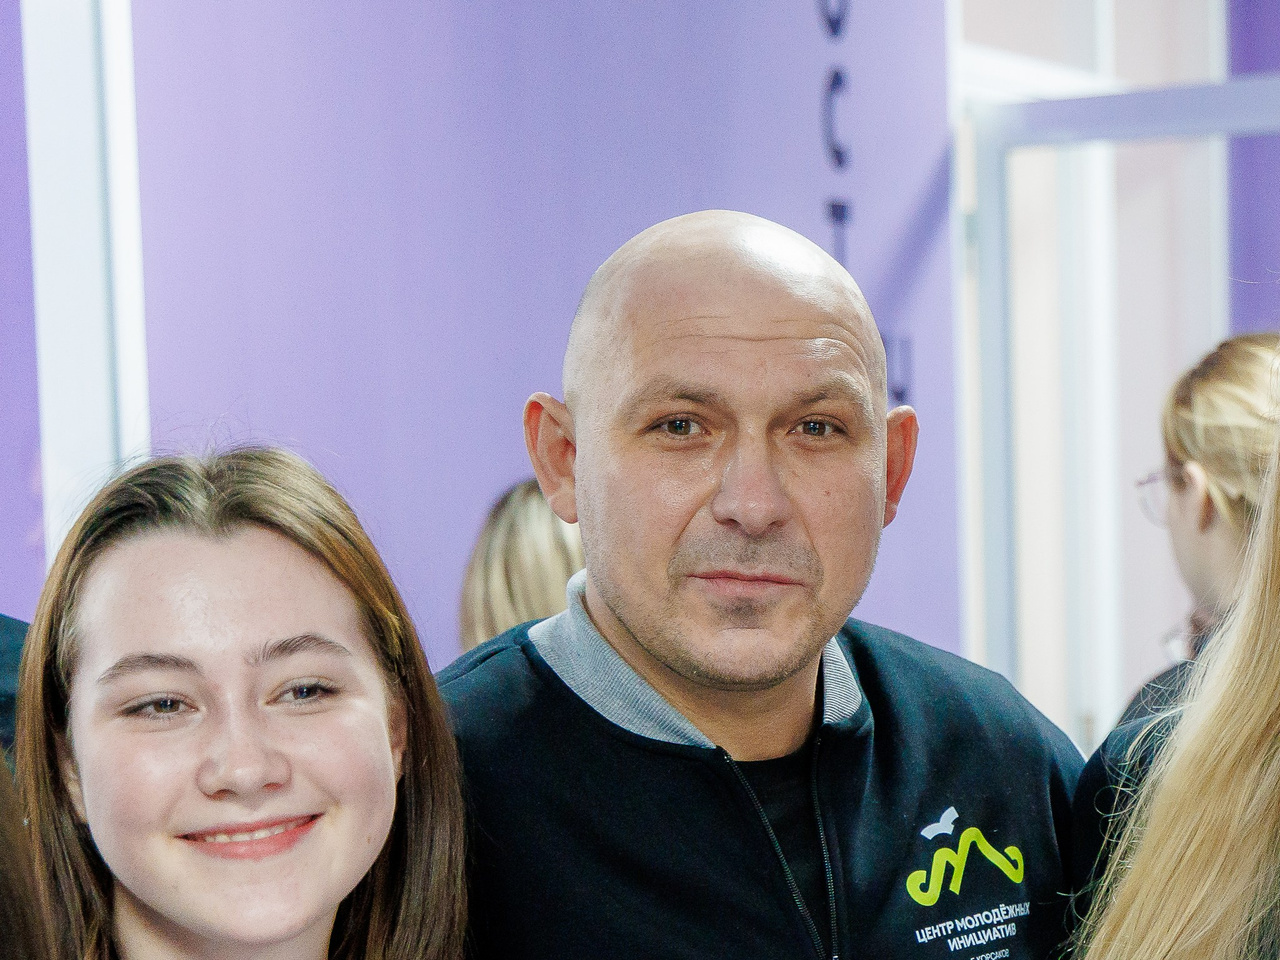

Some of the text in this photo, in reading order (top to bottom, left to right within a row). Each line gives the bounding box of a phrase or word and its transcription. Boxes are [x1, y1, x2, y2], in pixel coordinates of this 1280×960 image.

[915, 902, 1031, 943] ЦЕНТР МОЛОДЁЖНЫХ
[947, 922, 1017, 951] ИНИЦИАТИВ
